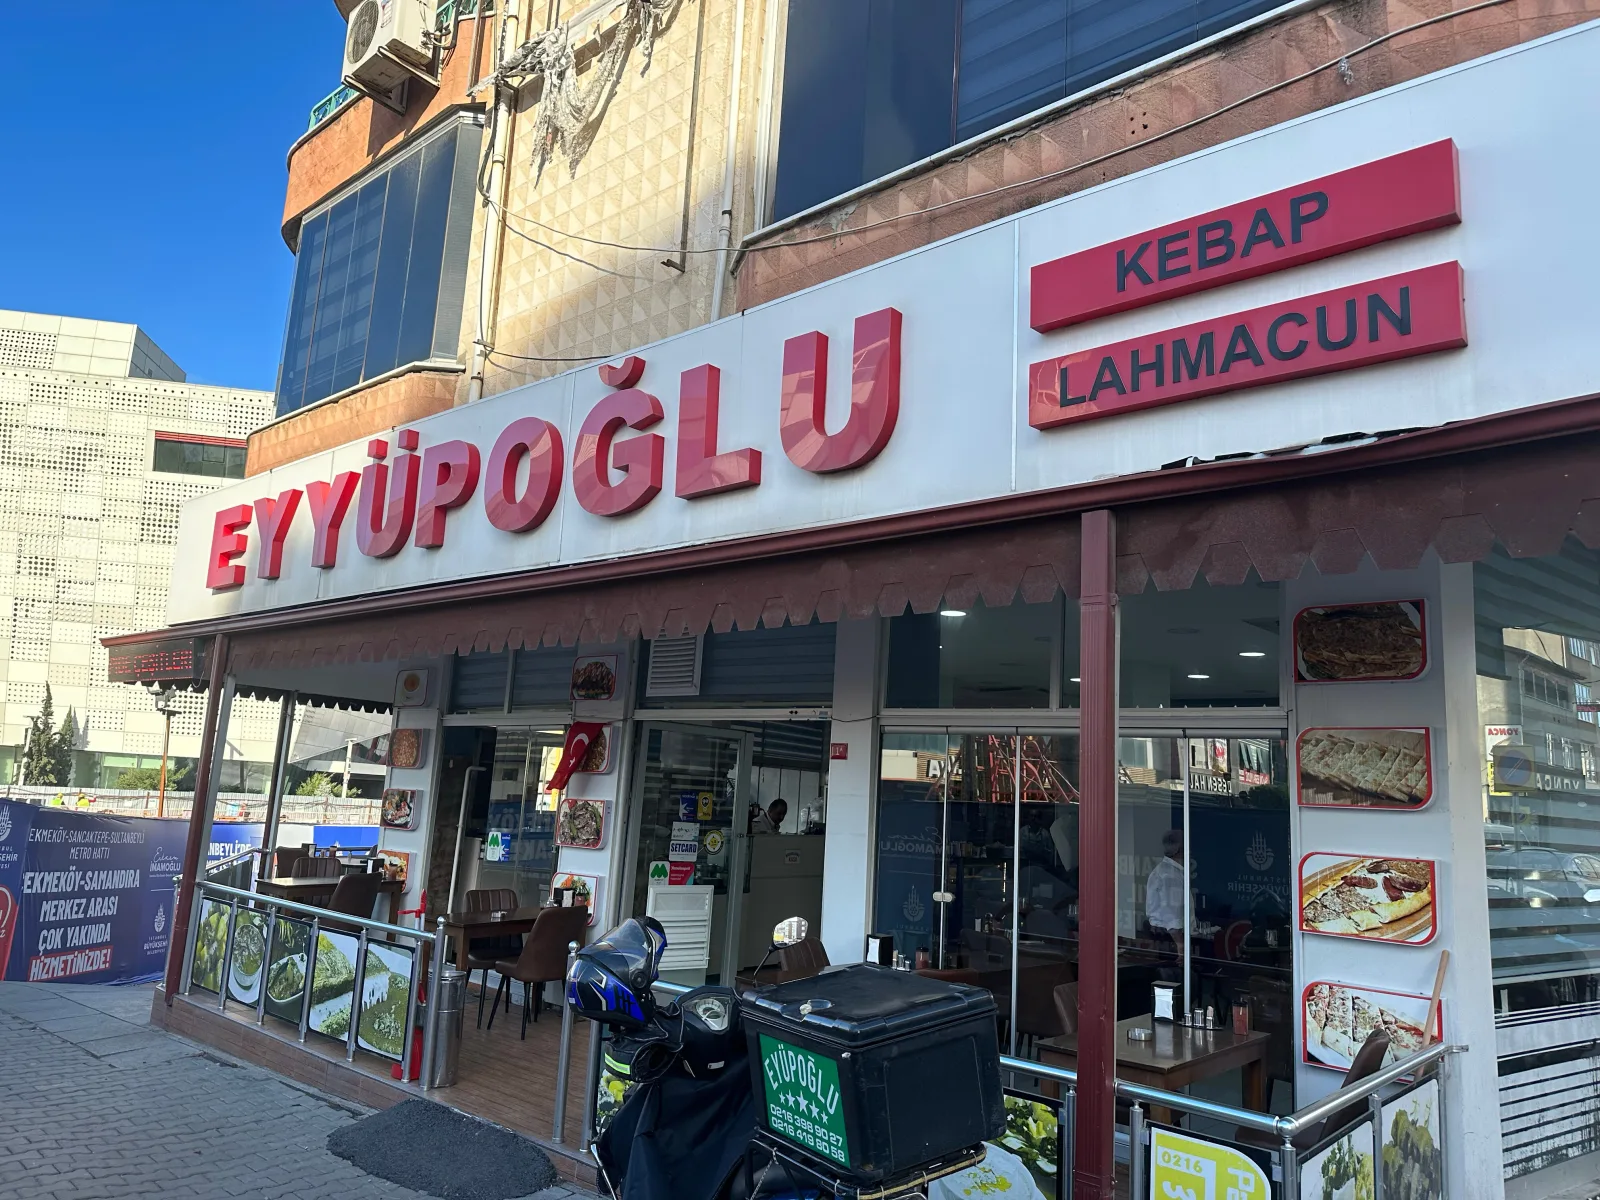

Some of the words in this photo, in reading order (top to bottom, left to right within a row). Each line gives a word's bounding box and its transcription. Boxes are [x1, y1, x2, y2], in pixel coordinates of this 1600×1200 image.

[1116, 191, 1330, 293] KEBAP
[1059, 286, 1412, 408] LAHMACUN
[206, 306, 903, 590] EYYÜPOĞLU
[69, 847, 91, 860] METRO
[92, 847, 110, 859] HATTI
[671, 843, 697, 853] SETCARD
[22, 865, 140, 893] EKMEKÖY-SAMANDIRA
[39, 898, 86, 922] MERKEZ
[87, 896, 119, 918] ARASI
[38, 927, 64, 956] ÇOK
[66, 923, 111, 947] YAKINDA
[29, 948, 111, 981] HİZMETİNİZDE!
[764, 1044, 839, 1114] EYÜPOĞLU
[770, 1103, 793, 1123] 0216
[794, 1115, 813, 1133] 398
[814, 1125, 828, 1140] 90
[829, 1132, 843, 1147] 27
[771, 1116, 795, 1136] 0216
[796, 1129, 814, 1146] 419
[816, 1138, 829, 1154] 80
[830, 1145, 845, 1162] 58
[1162, 1151, 1203, 1173] 0216
